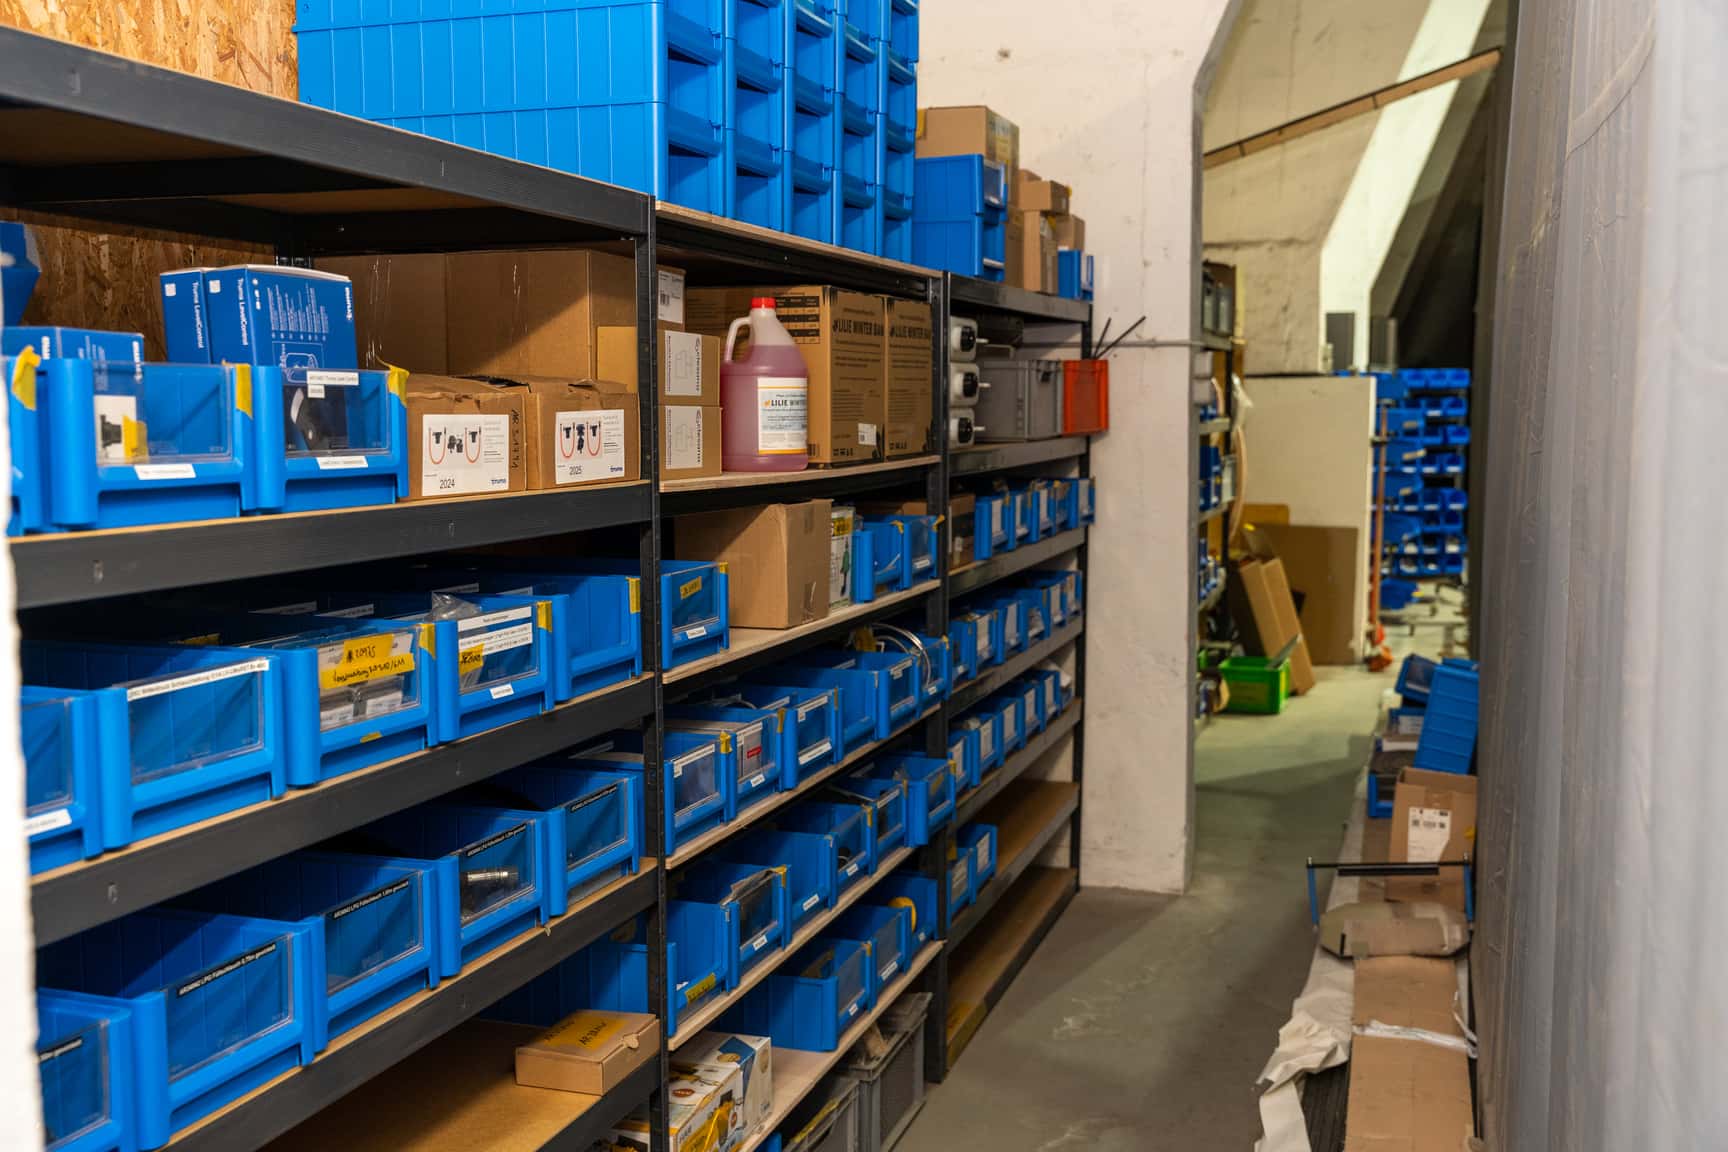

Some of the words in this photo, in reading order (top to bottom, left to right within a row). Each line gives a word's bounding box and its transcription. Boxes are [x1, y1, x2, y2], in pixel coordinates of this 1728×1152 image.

[192, 281, 200, 304] Truma
[237, 278, 245, 301] Truma
[239, 302, 249, 346] LevelControl
[839, 319, 852, 334] LILIE
[853, 320, 873, 336] WINTER
[771, 399, 788, 407] LILIE
[439, 479, 455, 489] 2024
